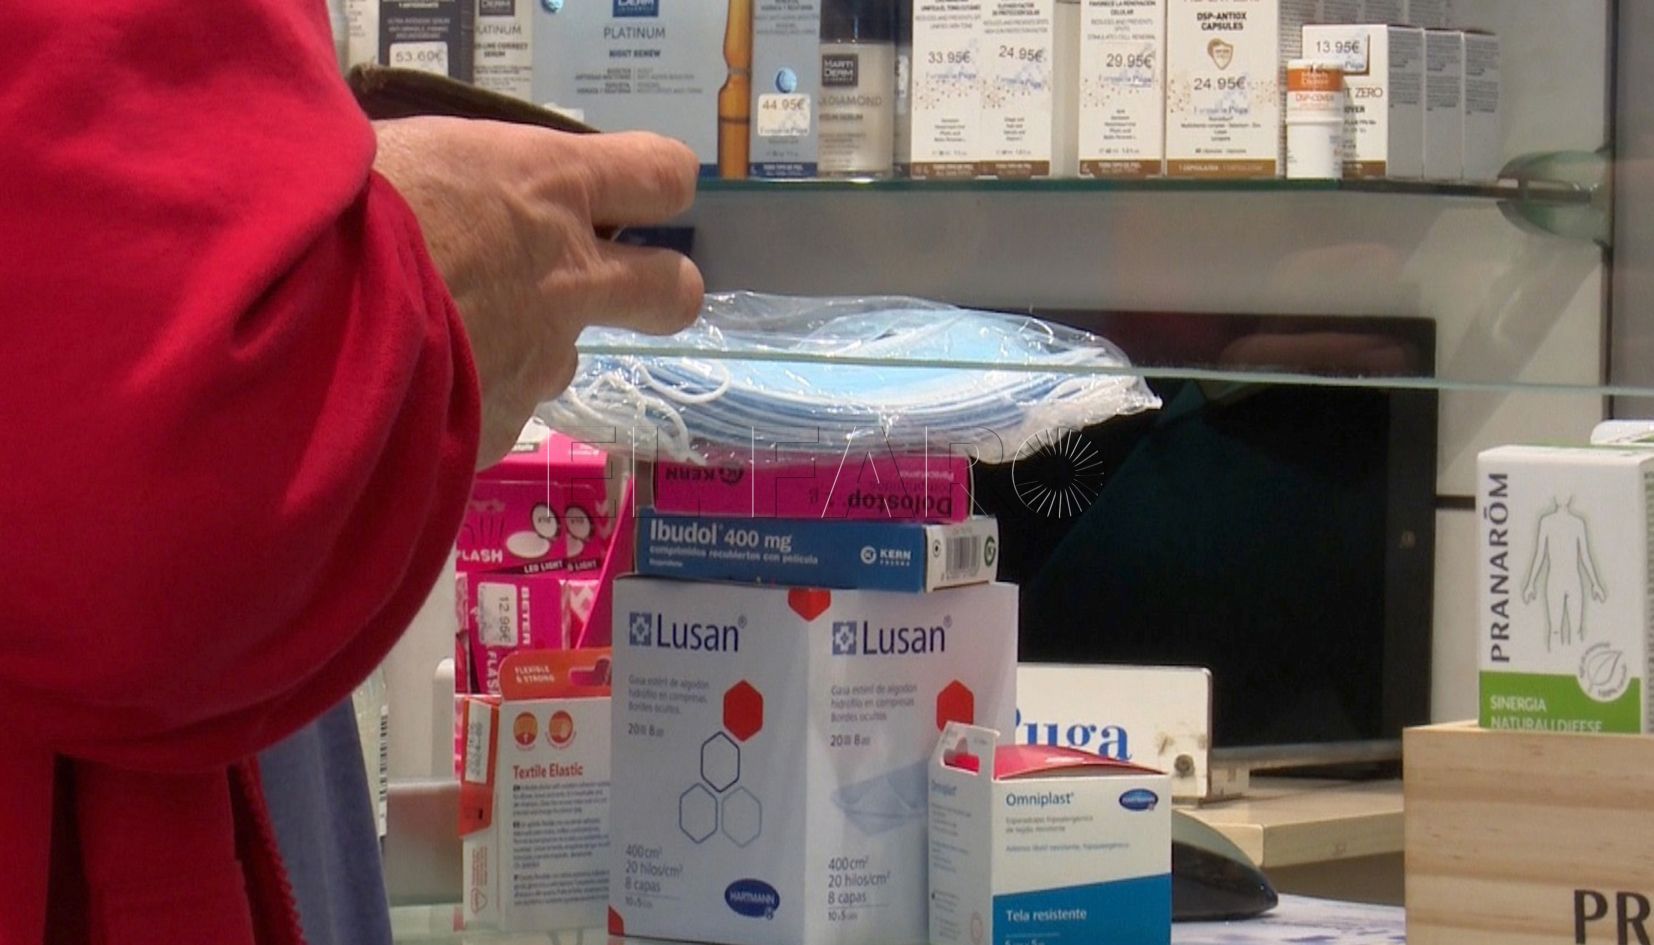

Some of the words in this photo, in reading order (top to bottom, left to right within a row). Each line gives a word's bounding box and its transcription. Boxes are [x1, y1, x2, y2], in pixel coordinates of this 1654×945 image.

[1196, 12, 1247, 21] DSP-ANTIOX
[603, 26, 666, 39] PLATINUM
[1201, 22, 1244, 31] CAPSULES
[1355, 87, 1384, 98] ZERO
[665, 467, 715, 481] KERN
[847, 491, 952, 516] Dolostop
[724, 530, 759, 547] 400
[764, 534, 792, 552] mg
[763, 554, 780, 562] con
[880, 549, 911, 560] KERN
[1490, 695, 1547, 712] SINERGIA
[1015, 708, 1133, 761] uga
[513, 763, 547, 780] Textile
[549, 762, 584, 778] Elastic
[625, 875, 633, 890] 8
[634, 880, 662, 893] capas
[828, 874, 842, 888] 20
[828, 891, 836, 906] 8
[838, 891, 867, 907] capas
[1006, 909, 1030, 922] Tela
[1032, 908, 1087, 921] resistente
